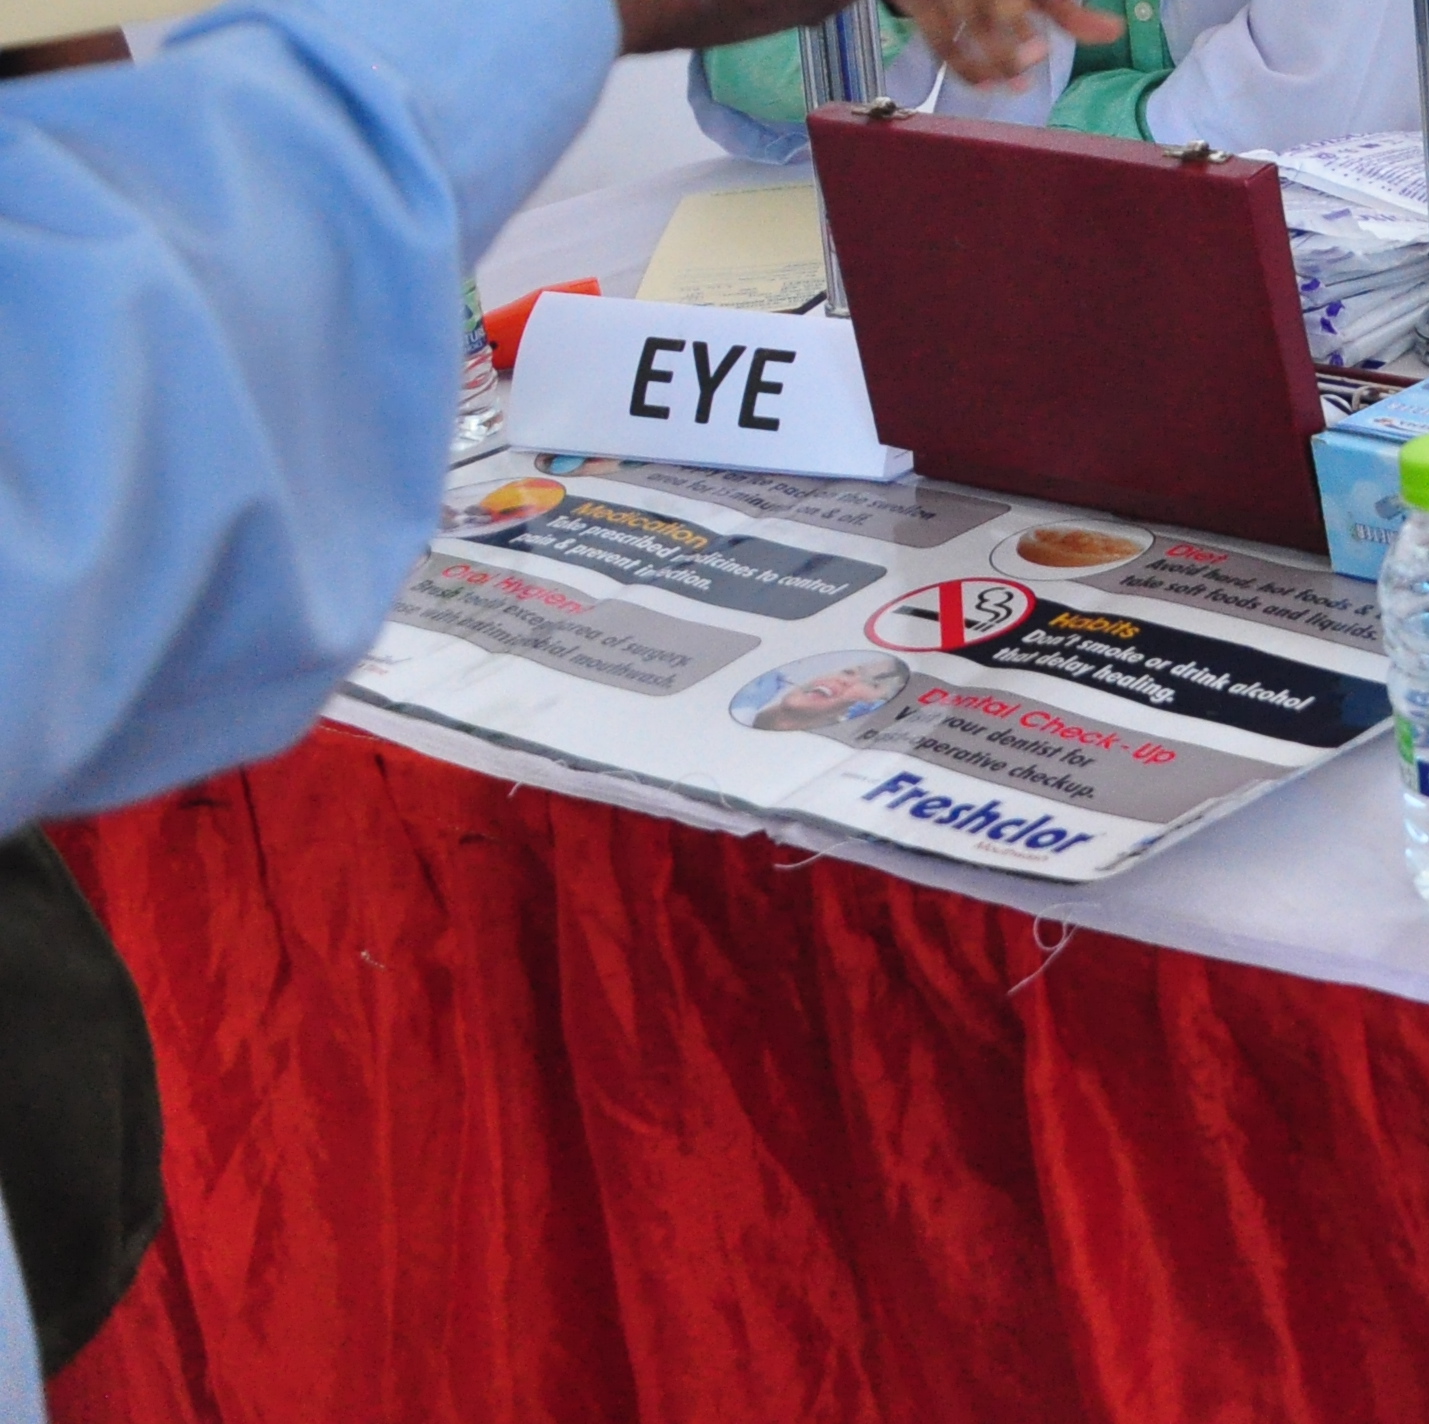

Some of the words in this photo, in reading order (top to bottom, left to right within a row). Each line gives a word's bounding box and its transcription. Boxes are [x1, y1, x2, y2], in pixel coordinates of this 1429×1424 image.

[629, 335, 797, 432] EYE
[509, 532, 551, 550] pain
[564, 542, 634, 571] prevent
[570, 502, 708, 550] Medication
[1165, 543, 1229, 564] Diet
[578, 522, 679, 561] prescribed
[755, 569, 778, 583] to
[777, 574, 848, 596] control
[1146, 558, 1202, 578] Avoid
[1256, 581, 1297, 597] hot
[1295, 588, 1353, 614] foods
[410, 579, 460, 599] Brush
[1164, 579, 1207, 596] soft
[1205, 588, 1260, 610] foods
[1262, 605, 1308, 622] and
[1306, 612, 1377, 641] liquids.
[1048, 612, 1141, 640] Habits
[993, 646, 1038, 664] that
[1035, 651, 1096, 678] delay
[1092, 664, 1175, 704] healing.
[1076, 638, 1145, 664] smoke
[1144, 656, 1173, 671] or
[1171, 661, 1231, 690] drink
[1227, 680, 1316, 711] alcohol
[986, 726, 1062, 762] dentist
[1060, 748, 1096, 768] for
[1019, 709, 1121, 750] Check
[1130, 740, 1177, 766] Up
[1007, 764, 1095, 799] checkup.
[861, 770, 1095, 854] Freshclor
